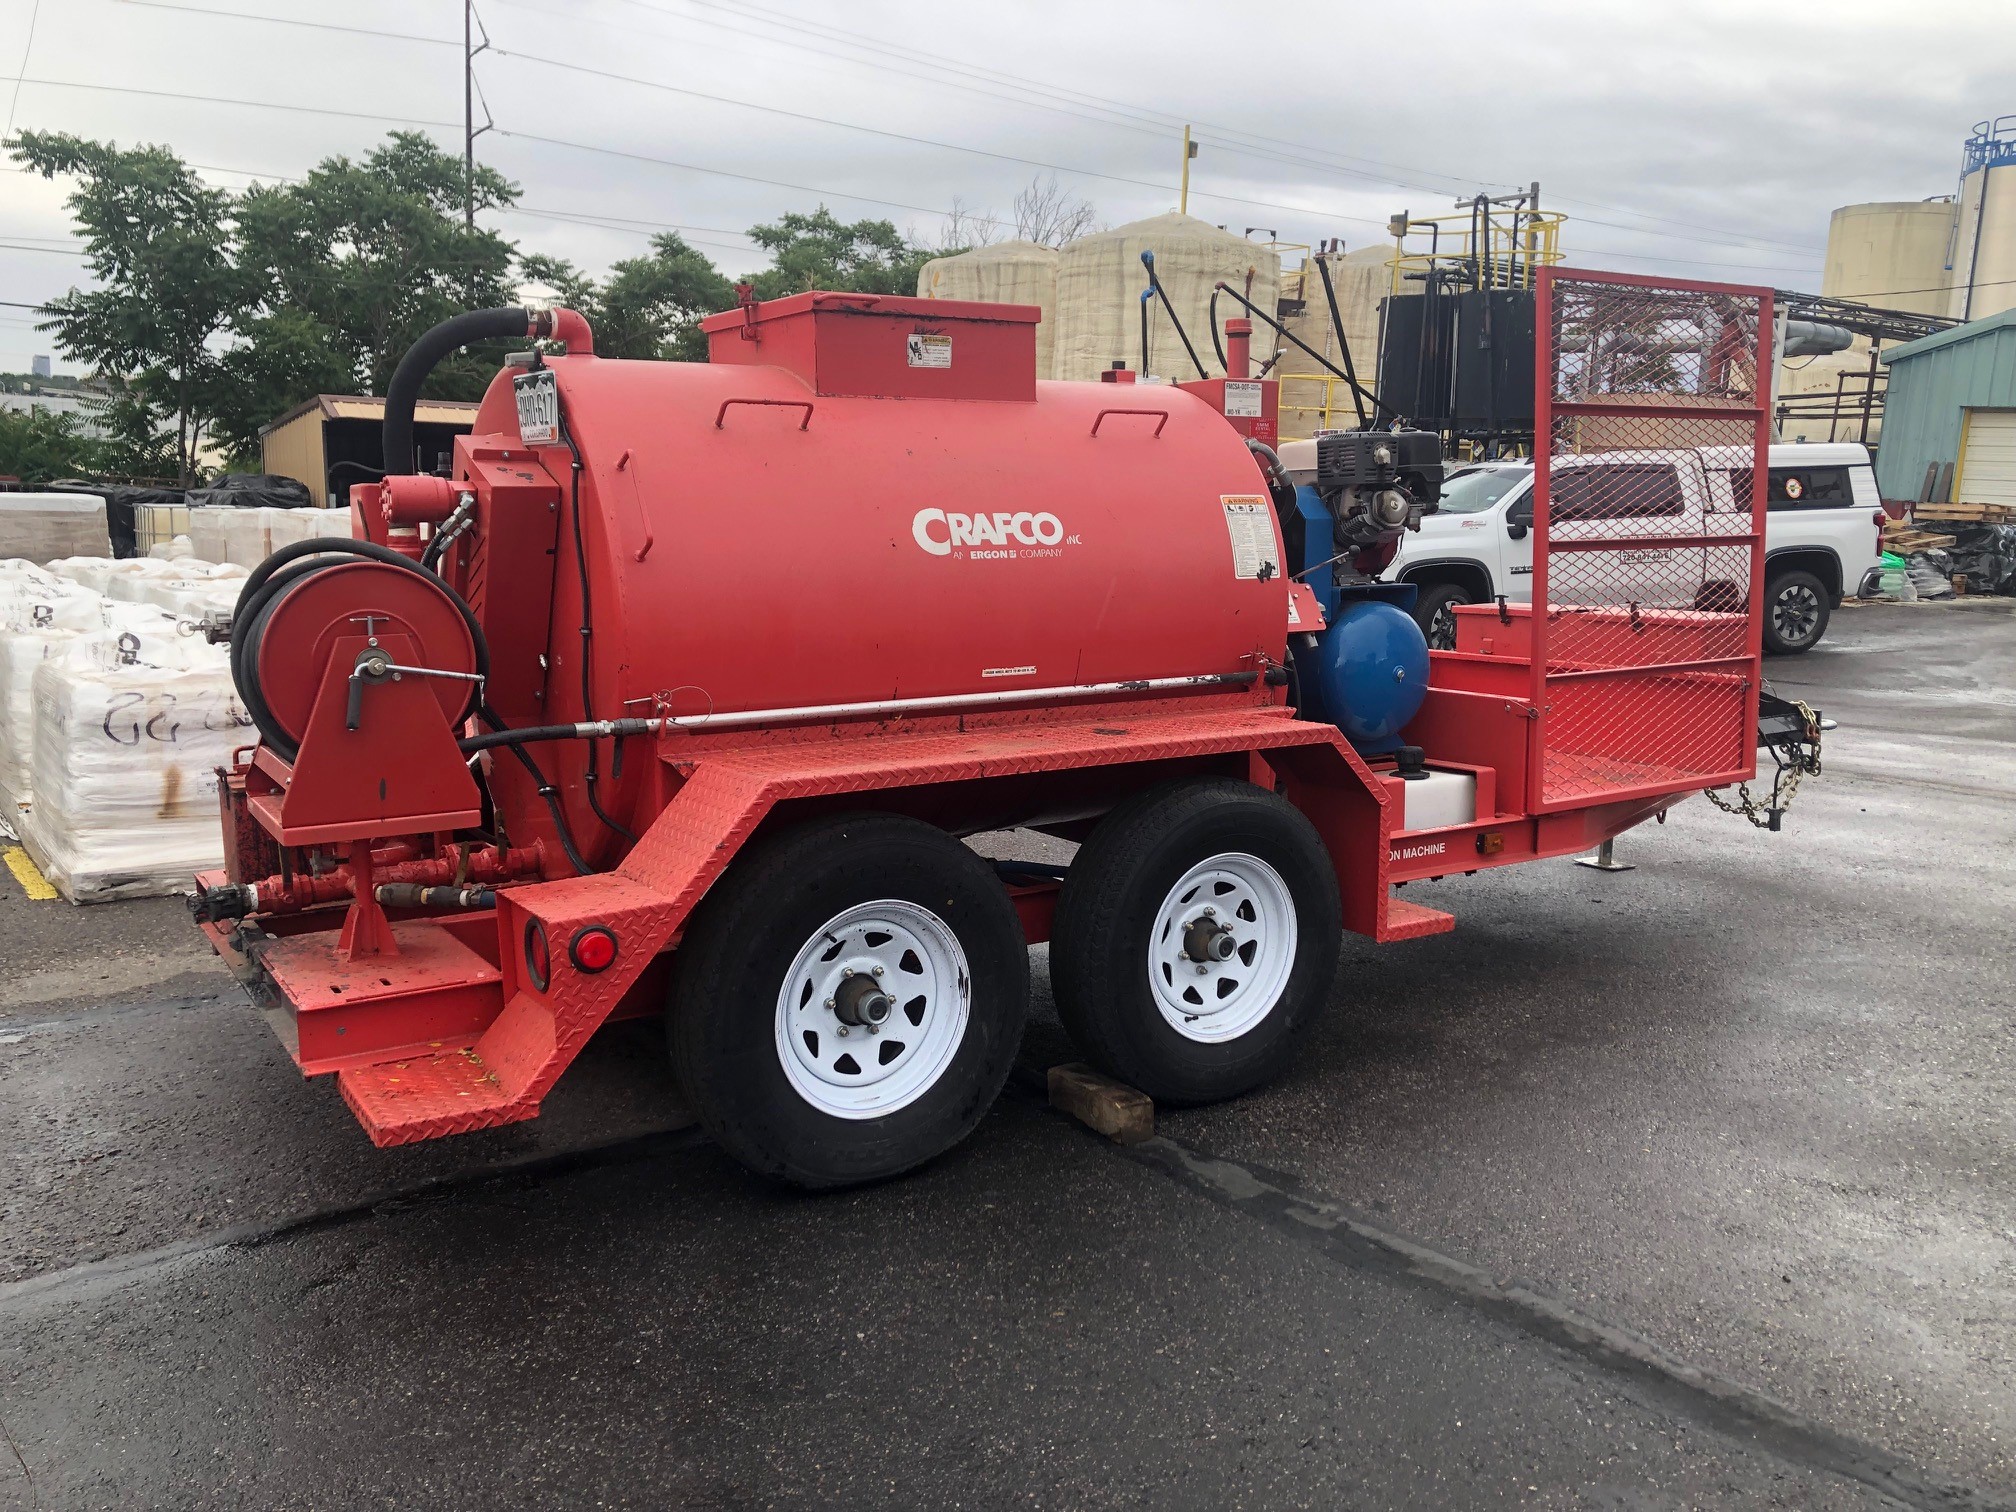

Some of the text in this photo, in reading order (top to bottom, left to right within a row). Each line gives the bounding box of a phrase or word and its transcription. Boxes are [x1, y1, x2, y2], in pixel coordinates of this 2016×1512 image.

[912, 507, 1082, 556] CRAFCO INC
[970, 551, 1008, 559] ERGON
[1020, 549, 1063, 558] COMPANY
[1403, 843, 1446, 859] MACHINE
